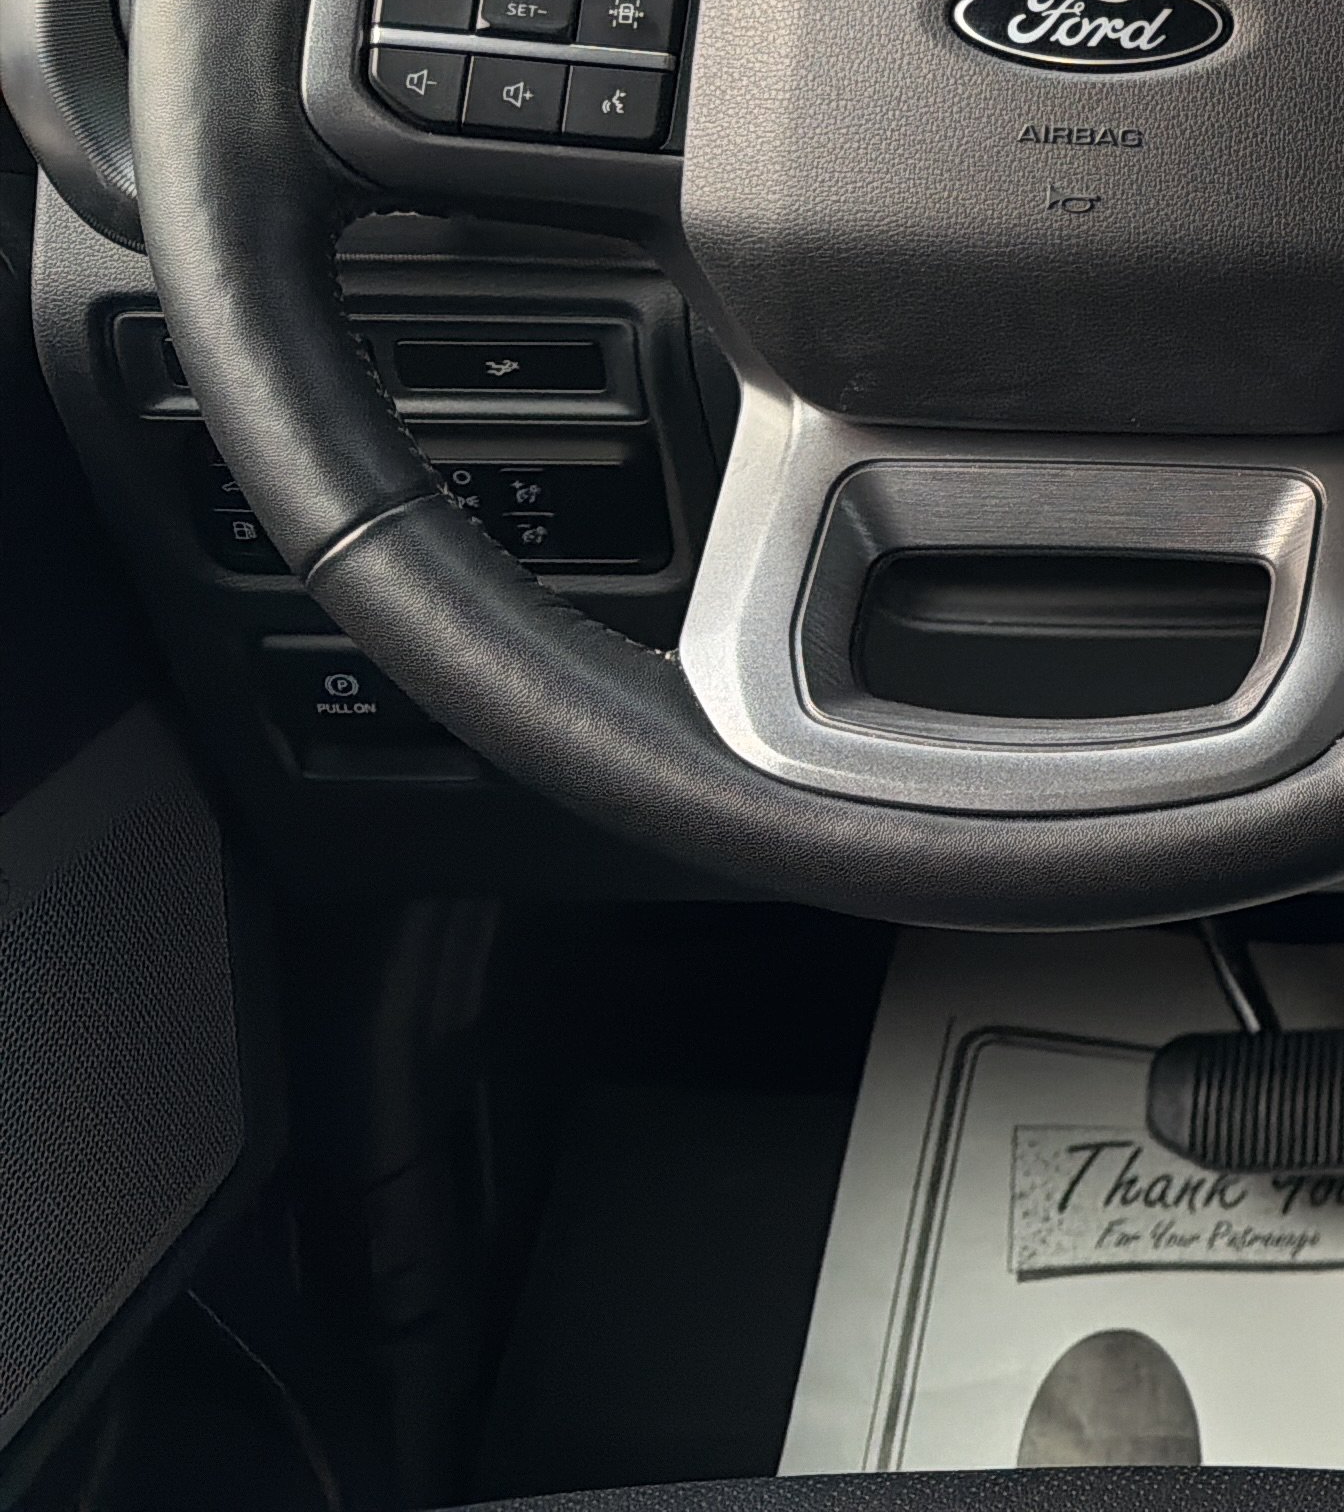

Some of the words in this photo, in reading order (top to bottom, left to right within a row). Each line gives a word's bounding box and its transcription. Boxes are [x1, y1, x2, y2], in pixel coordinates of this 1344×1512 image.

[1016, 123, 1145, 149] AIRBAG
[316, 703, 353, 714] PULL
[353, 702, 377, 714] ON
[1056, 1139, 1250, 1215] Thank
[1094, 1216, 1142, 1250] For
[1148, 1218, 1204, 1251] Your
